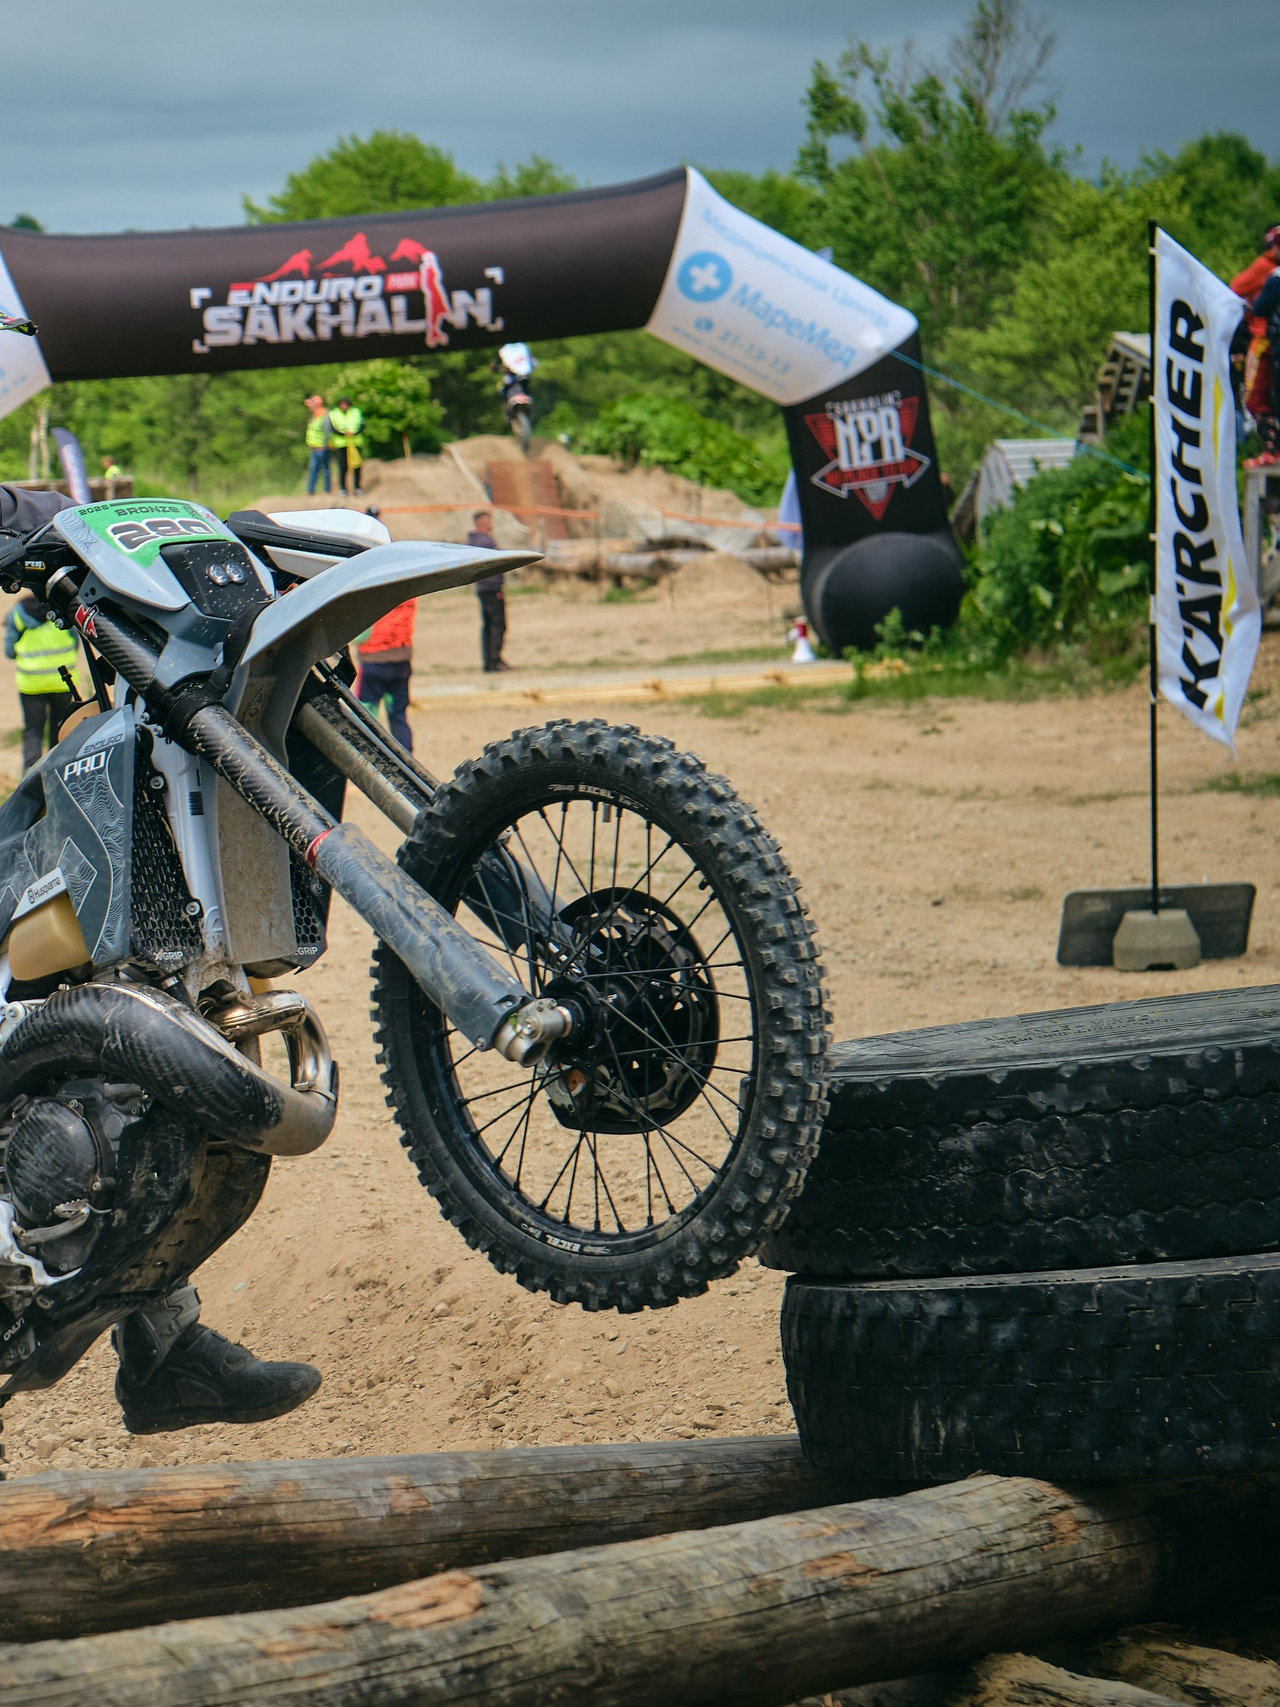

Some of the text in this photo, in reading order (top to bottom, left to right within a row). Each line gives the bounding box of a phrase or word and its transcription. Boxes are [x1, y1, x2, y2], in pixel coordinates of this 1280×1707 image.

[227, 274, 385, 307] ENDURO
[114, 505, 181, 517] BRONZE
[1166, 297, 1222, 711] KÄRCHER
[107, 518, 217, 552] 280
[84, 733, 124, 754] ENDURO
[63, 751, 107, 781] PRO
[578, 784, 615, 799] EXCEL
[34, 876, 61, 899] Husqvarna
[153, 950, 184, 962] X-GRIP
[546, 1234, 581, 1254] EXCEL
